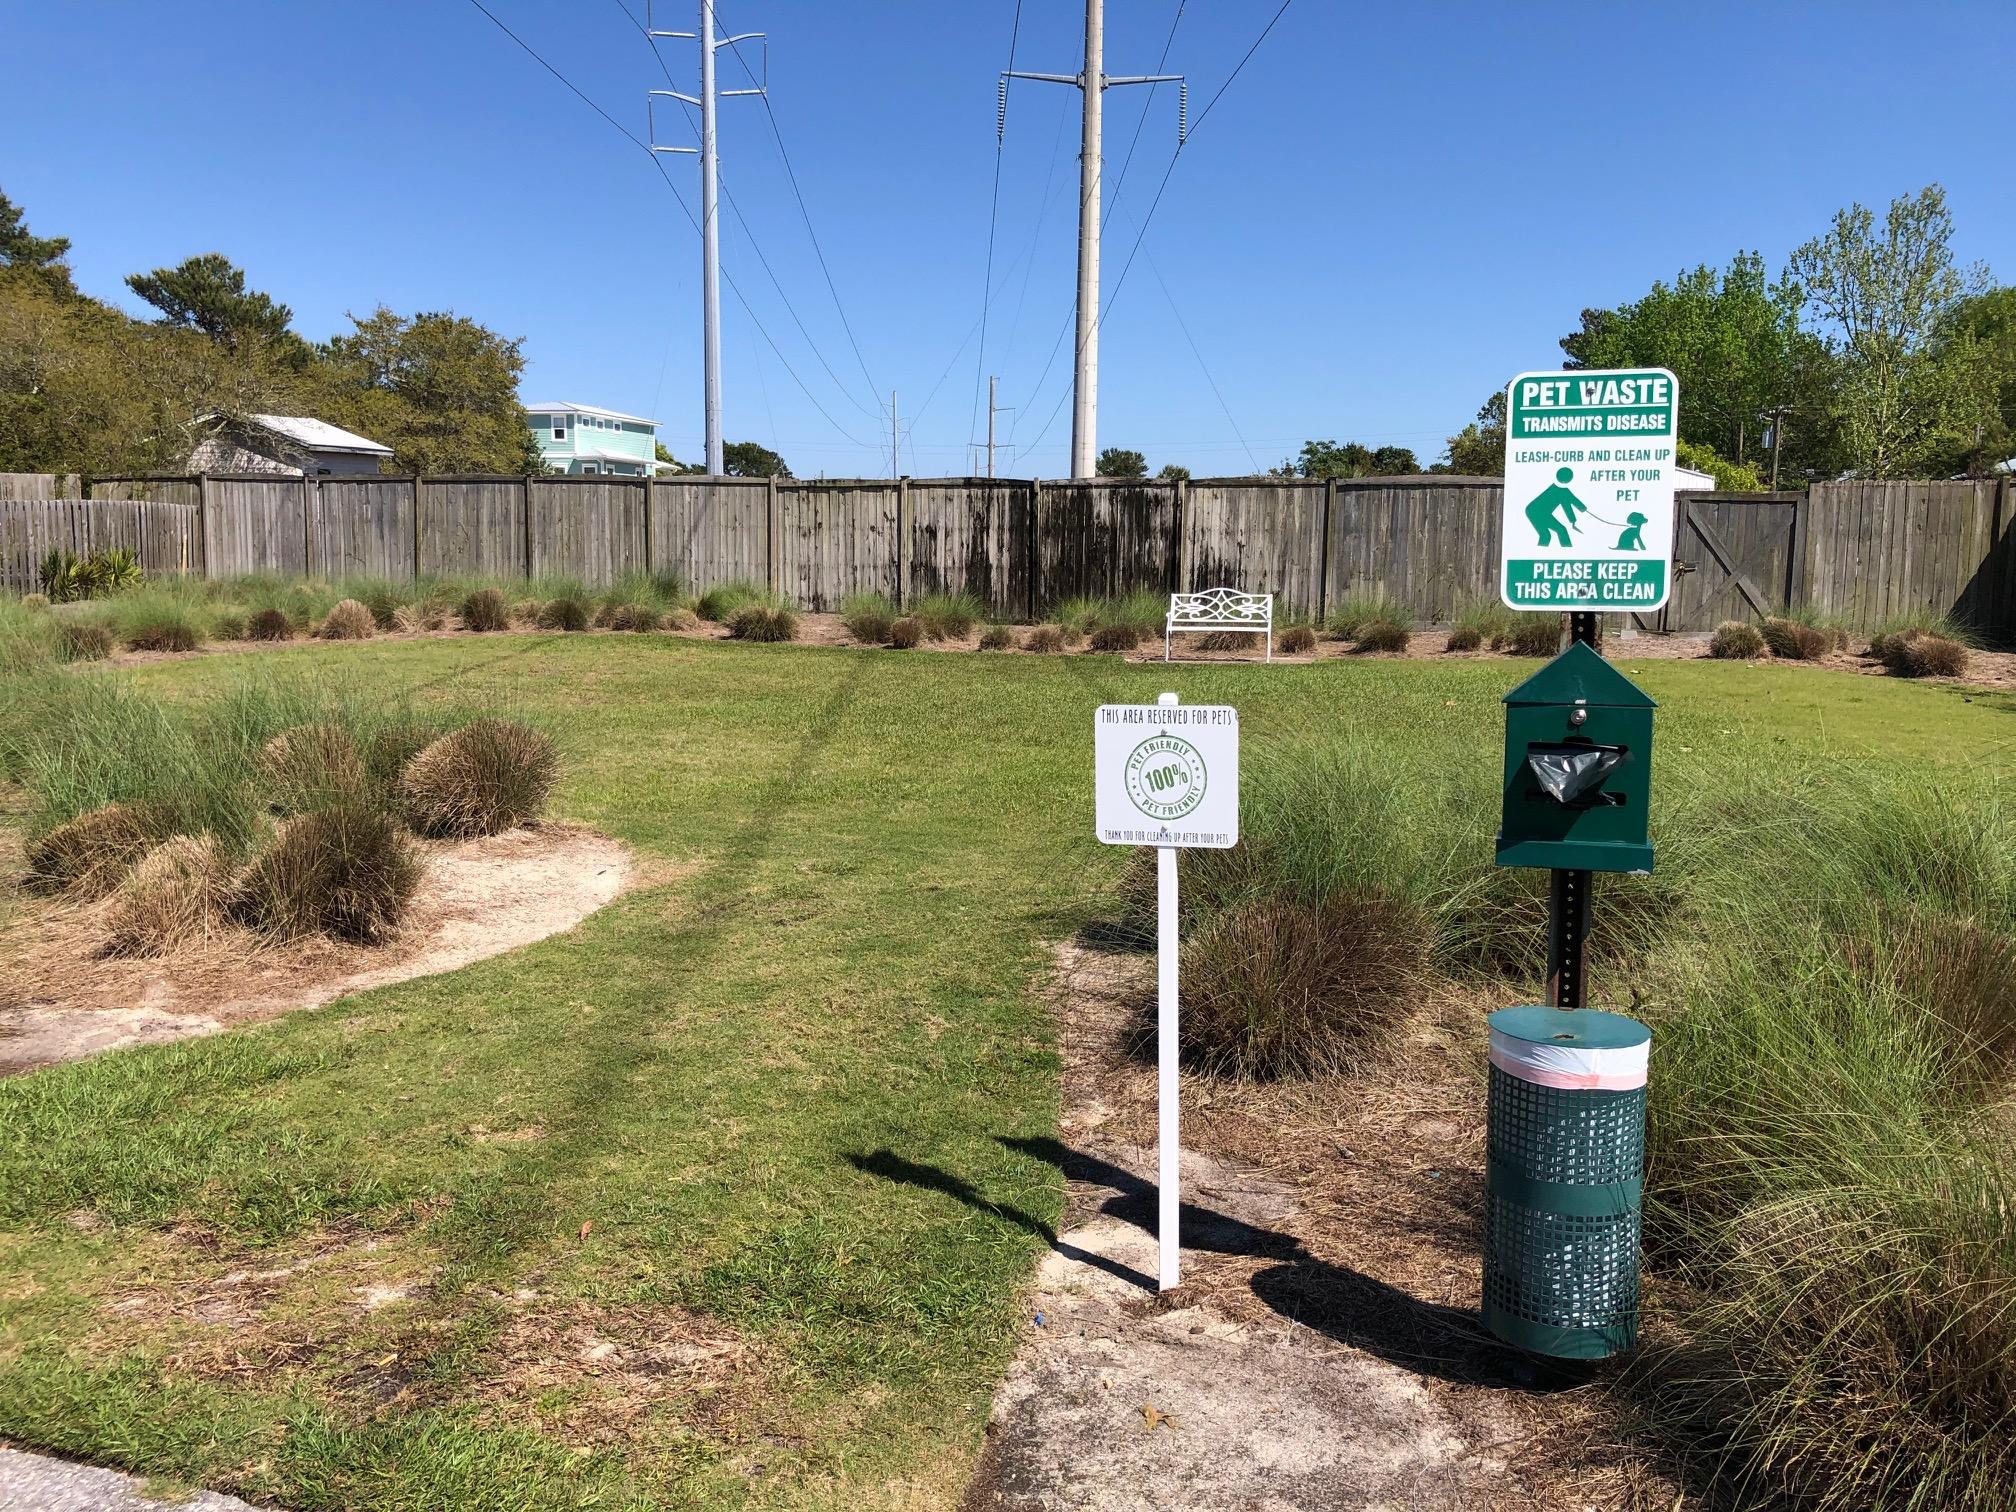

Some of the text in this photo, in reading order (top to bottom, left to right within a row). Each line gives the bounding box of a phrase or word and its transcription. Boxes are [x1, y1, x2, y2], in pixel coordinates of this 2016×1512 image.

[1522, 378, 1668, 407] PET WASTE
[1522, 413, 1666, 433] TRANSMITS DISEASE
[1515, 449, 1671, 463] LEASH-CURB AND CLEAN UP
[1590, 469, 1660, 482] AFTER YOUR
[1616, 489, 1640, 501] PET
[1533, 562, 1638, 580] PLEASE KEEP
[1515, 582, 1551, 599] THIS
[1603, 582, 1655, 600] CLEAN
[1101, 708, 1232, 725] THIS AREA RESERVED FOR PETS
[1130, 740, 1190, 770] PET FRIENDLY
[1144, 762, 1188, 793] 100%
[1142, 785, 1201, 816] PET FRIENDLY
[1104, 829, 1229, 845] THANK YOU FOR CLEANING UP AFTER YOUR PETS
